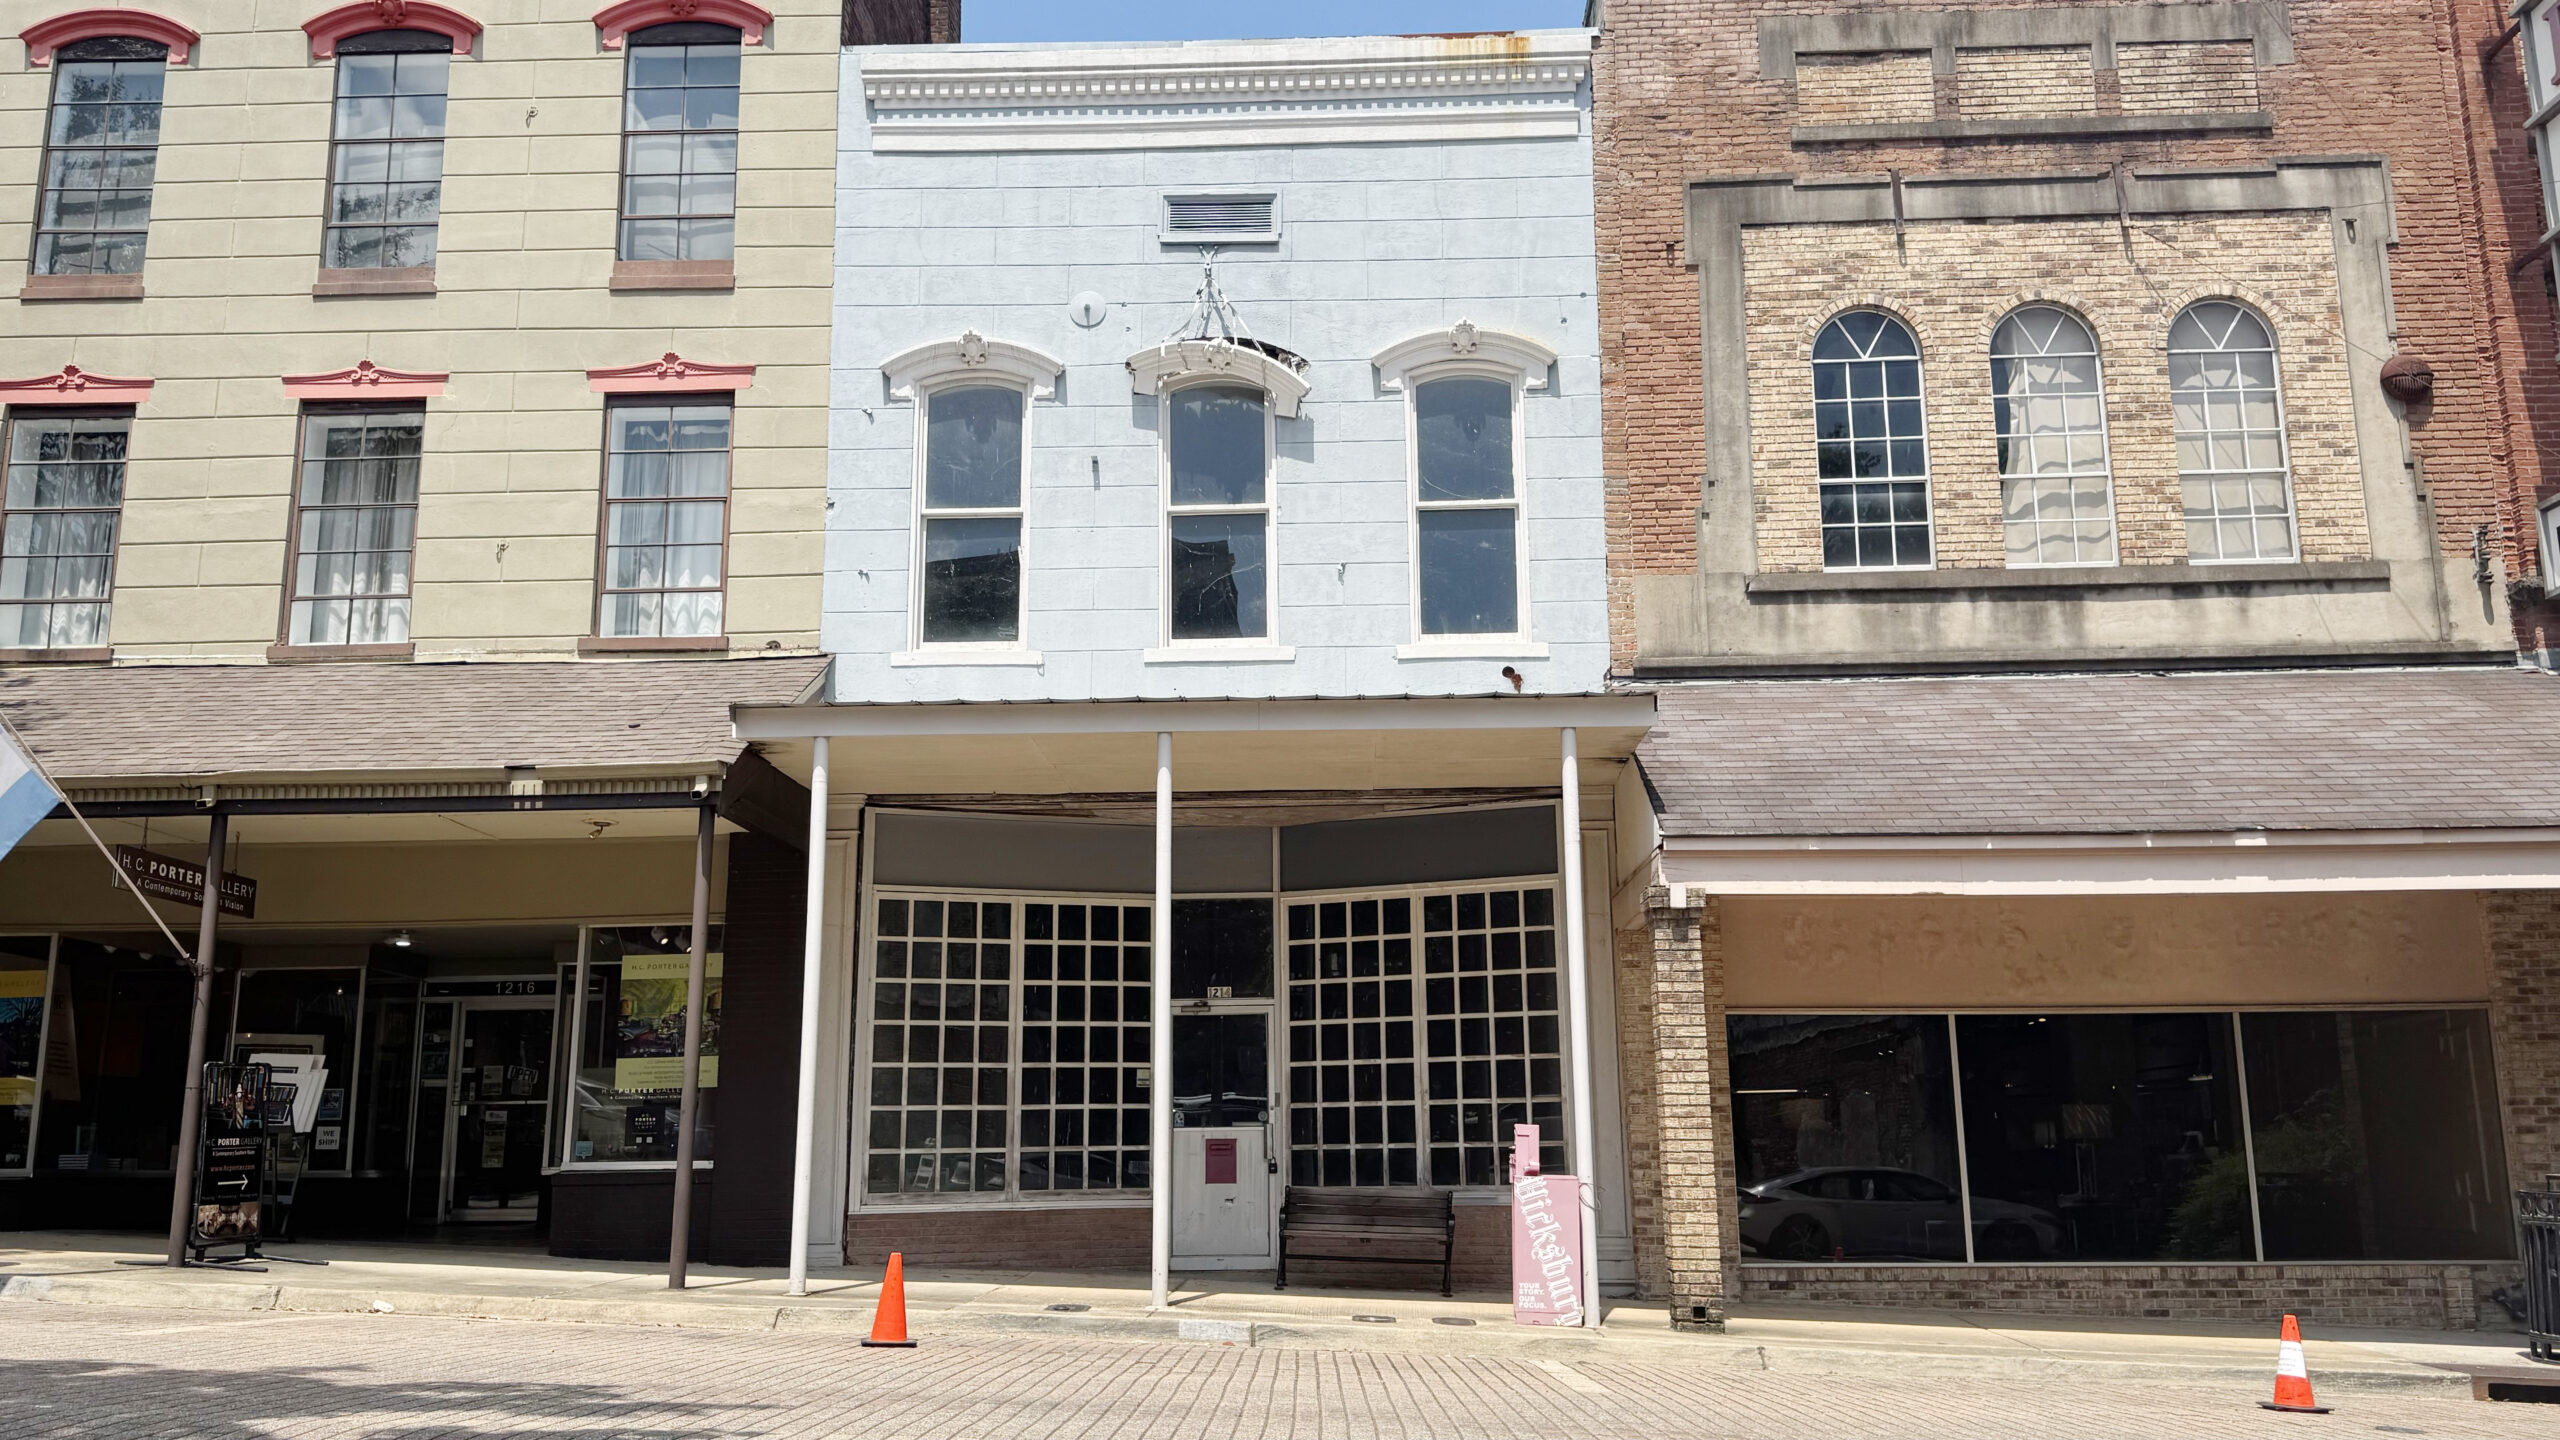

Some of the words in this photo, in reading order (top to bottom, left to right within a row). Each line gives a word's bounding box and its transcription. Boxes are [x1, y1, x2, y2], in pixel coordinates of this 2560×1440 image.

[122, 854, 132, 868] H.
[135, 857, 145, 872] C.
[149, 861, 203, 886] PORTER
[221, 880, 254, 898] LLERY
[144, 880, 192, 900] Contemporary
[225, 898, 244, 911] Vision
[496, 982, 535, 994] 1216
[511, 1066, 537, 1084] OPEN
[217, 1137, 240, 1146] PORTER
[240, 1136, 263, 1145] GALLERY
[318, 1138, 338, 1146] SHIP!
[1518, 1288, 1545, 1296] STORY.
[1518, 1301, 1547, 1309] FOCUS.
